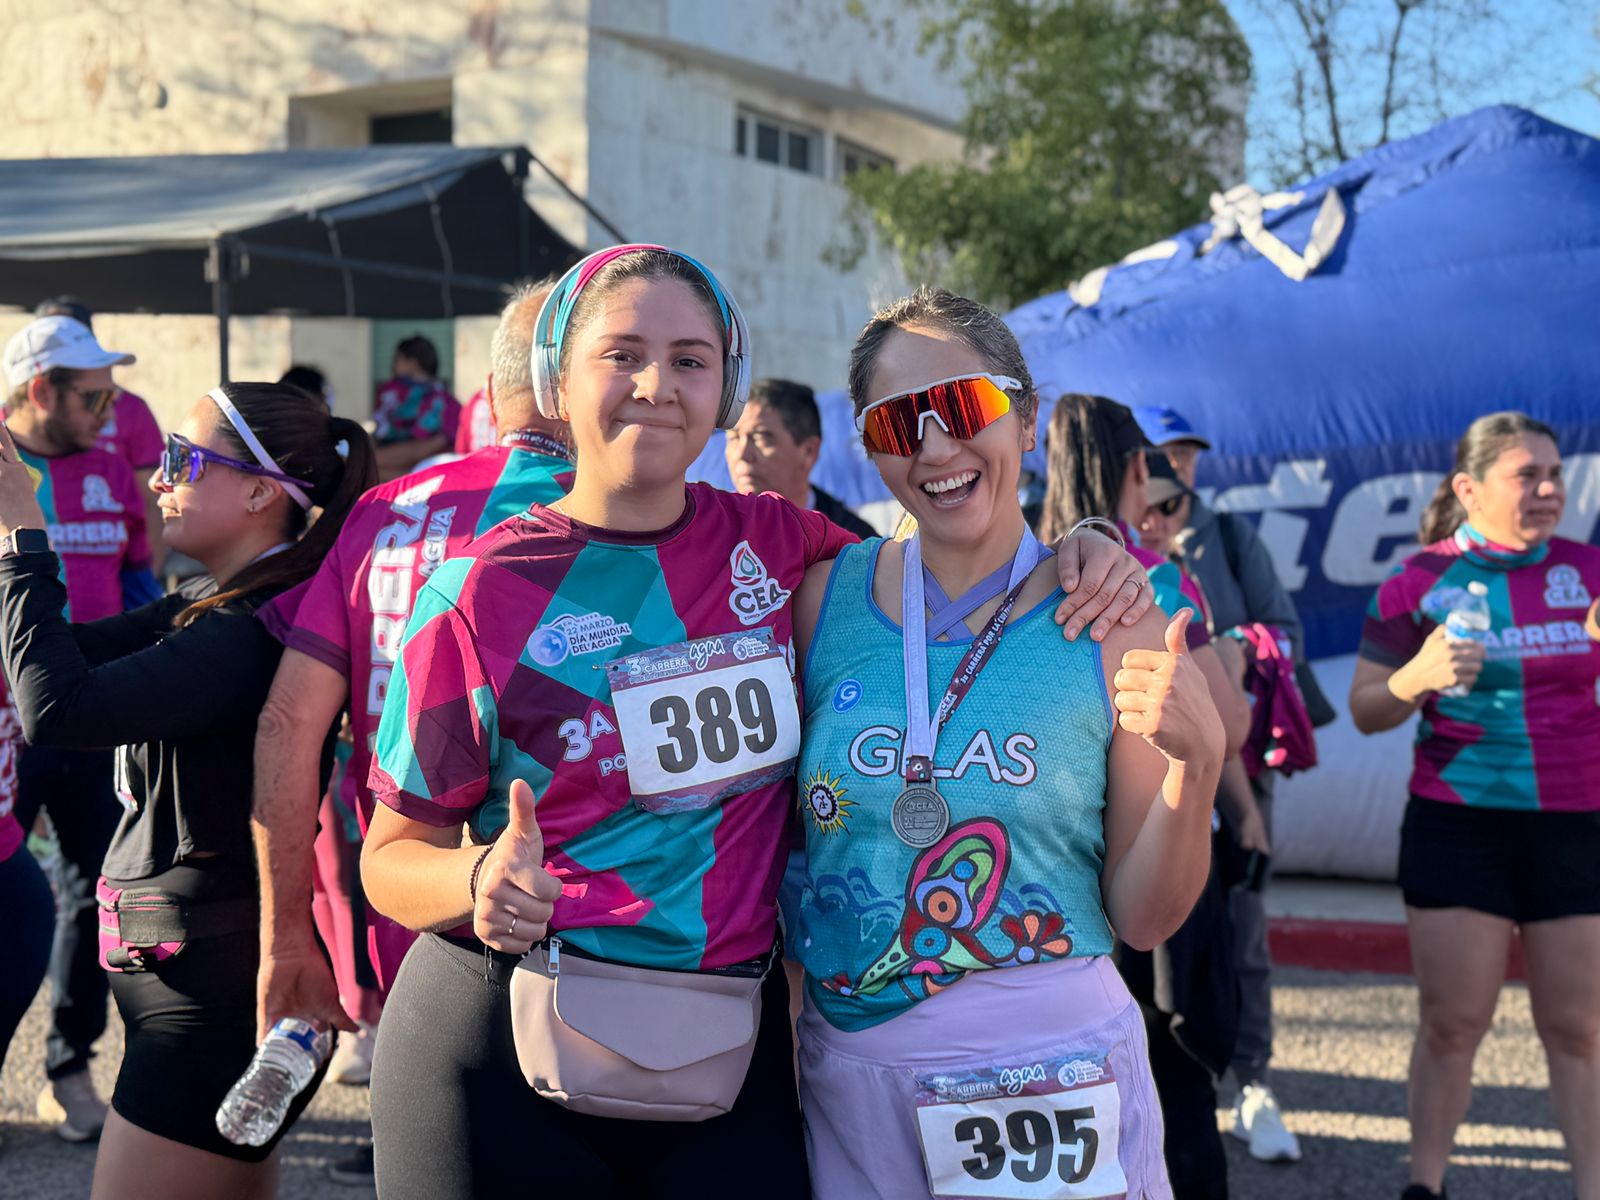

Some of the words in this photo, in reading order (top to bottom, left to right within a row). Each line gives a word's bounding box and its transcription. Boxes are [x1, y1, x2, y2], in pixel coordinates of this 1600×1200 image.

[420, 505, 457, 577] AGUA
[734, 583, 789, 614] CEA
[566, 627, 577, 636] 22
[580, 618, 613, 633] MARZO
[569, 632, 586, 646] DÍA
[588, 625, 630, 640] MUNDIAL
[572, 643, 589, 654] DEL
[591, 636, 620, 650] AGUA
[690, 640, 725, 670] agua
[965, 643, 987, 676] CARRERA
[984, 629, 996, 647] POR
[993, 619, 1002, 632] LA
[644, 657, 688, 673] CARRERA
[650, 678, 778, 774] 389
[1000, 1064, 1047, 1096] agua
[954, 1105, 1099, 1184] 395
